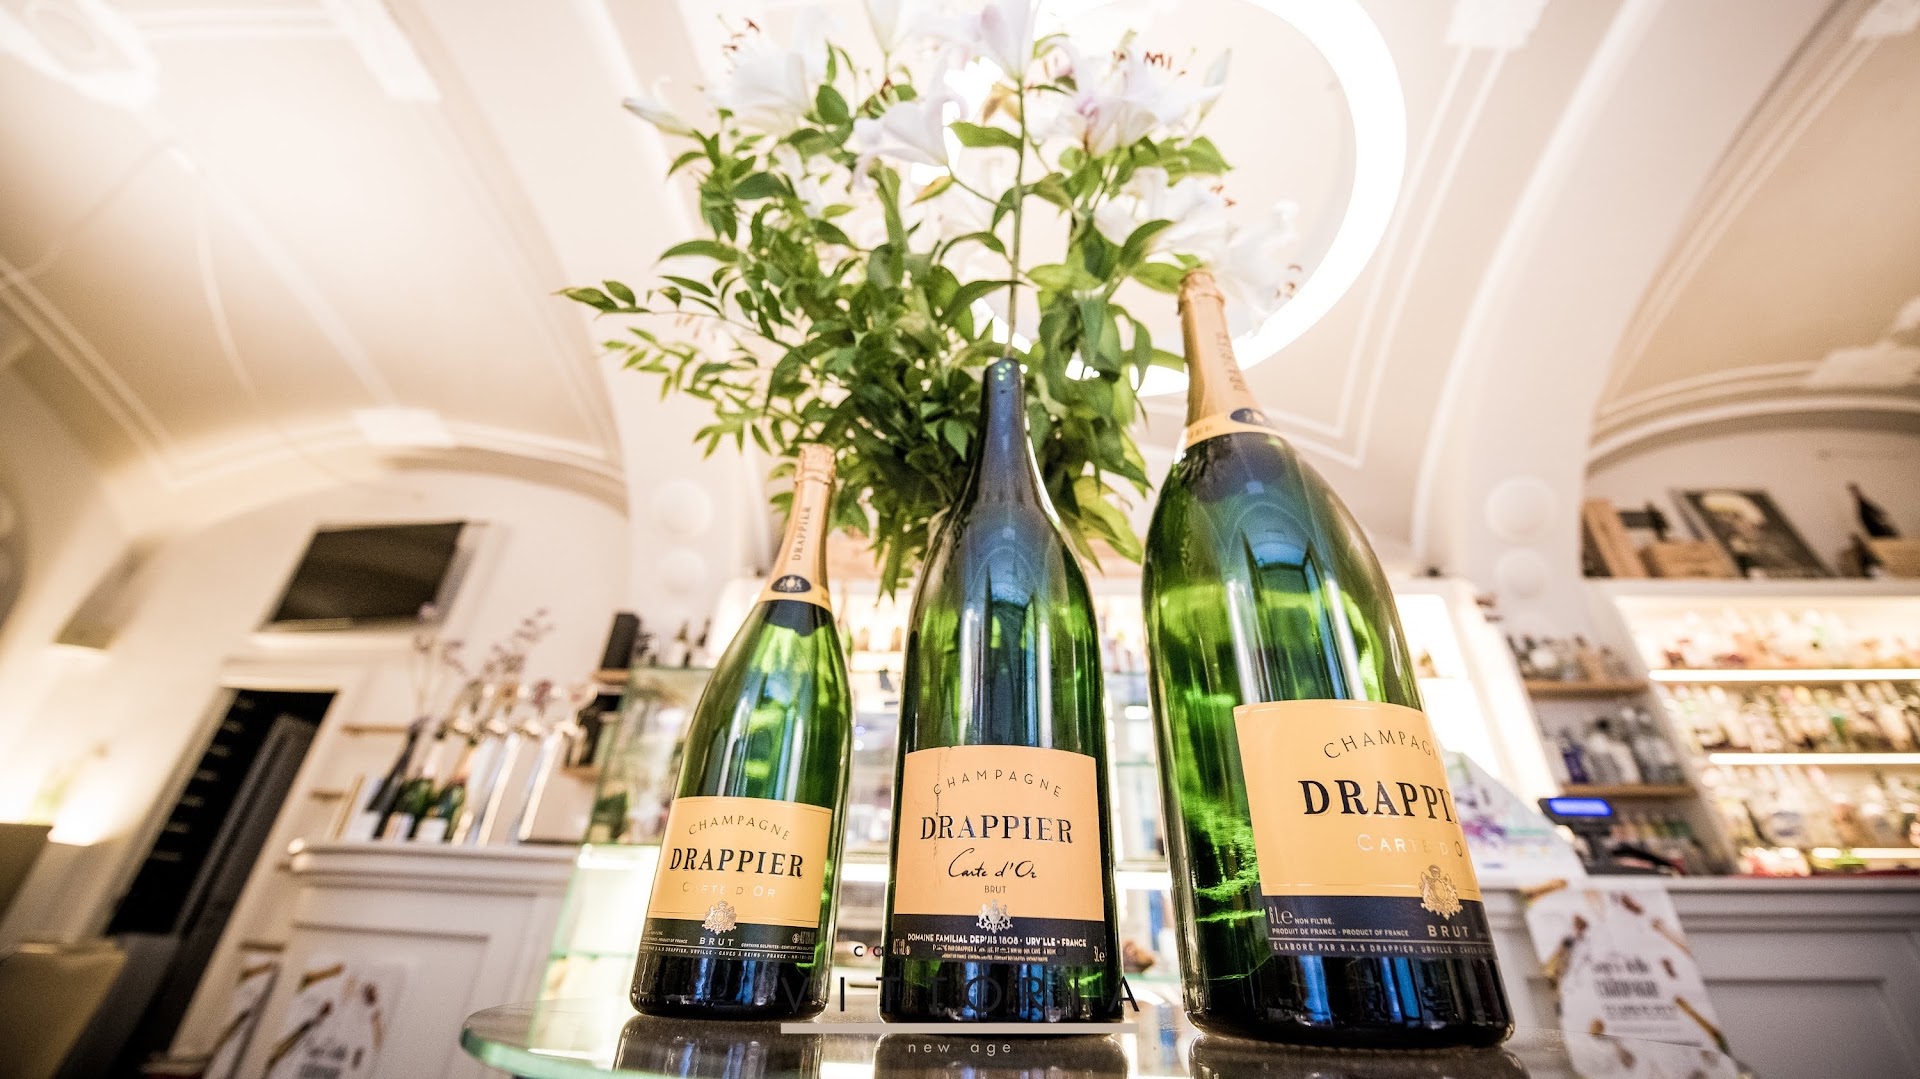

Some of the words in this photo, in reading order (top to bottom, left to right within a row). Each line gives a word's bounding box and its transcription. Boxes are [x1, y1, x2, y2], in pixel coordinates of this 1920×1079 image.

[791, 505, 811, 561] DRAPPIER
[933, 769, 1062, 797] CHAMPAGNE
[1298, 779, 1459, 825] DRAPPI
[688, 815, 790, 841] CHAMPAGNE
[920, 815, 1073, 844] DRAPPIER
[669, 848, 804, 879] DRAPPIER
[948, 848, 988, 878] Carte
[994, 860, 1038, 879] d'Or
[984, 885, 1007, 894] BRUT
[1294, 917, 1309, 925] NON
[1427, 924, 1469, 938] BRUT
[698, 936, 734, 947] BRUT
[907, 933, 934, 942] DOMAINE
[935, 934, 968, 944] FAMILIAL
[999, 936, 1019, 945] 1808
[1061, 938, 1087, 948] FRANCE
[1271, 927, 1298, 935] PRODUIT
[1310, 928, 1337, 936] FRANCE
[1342, 928, 1373, 936] PRODUCT
[1384, 929, 1410, 937] FRANCE
[1273, 941, 1314, 951] ÉLABORÉ
[1318, 943, 1336, 952] PAR
[1421, 945, 1453, 954] URVILLE
